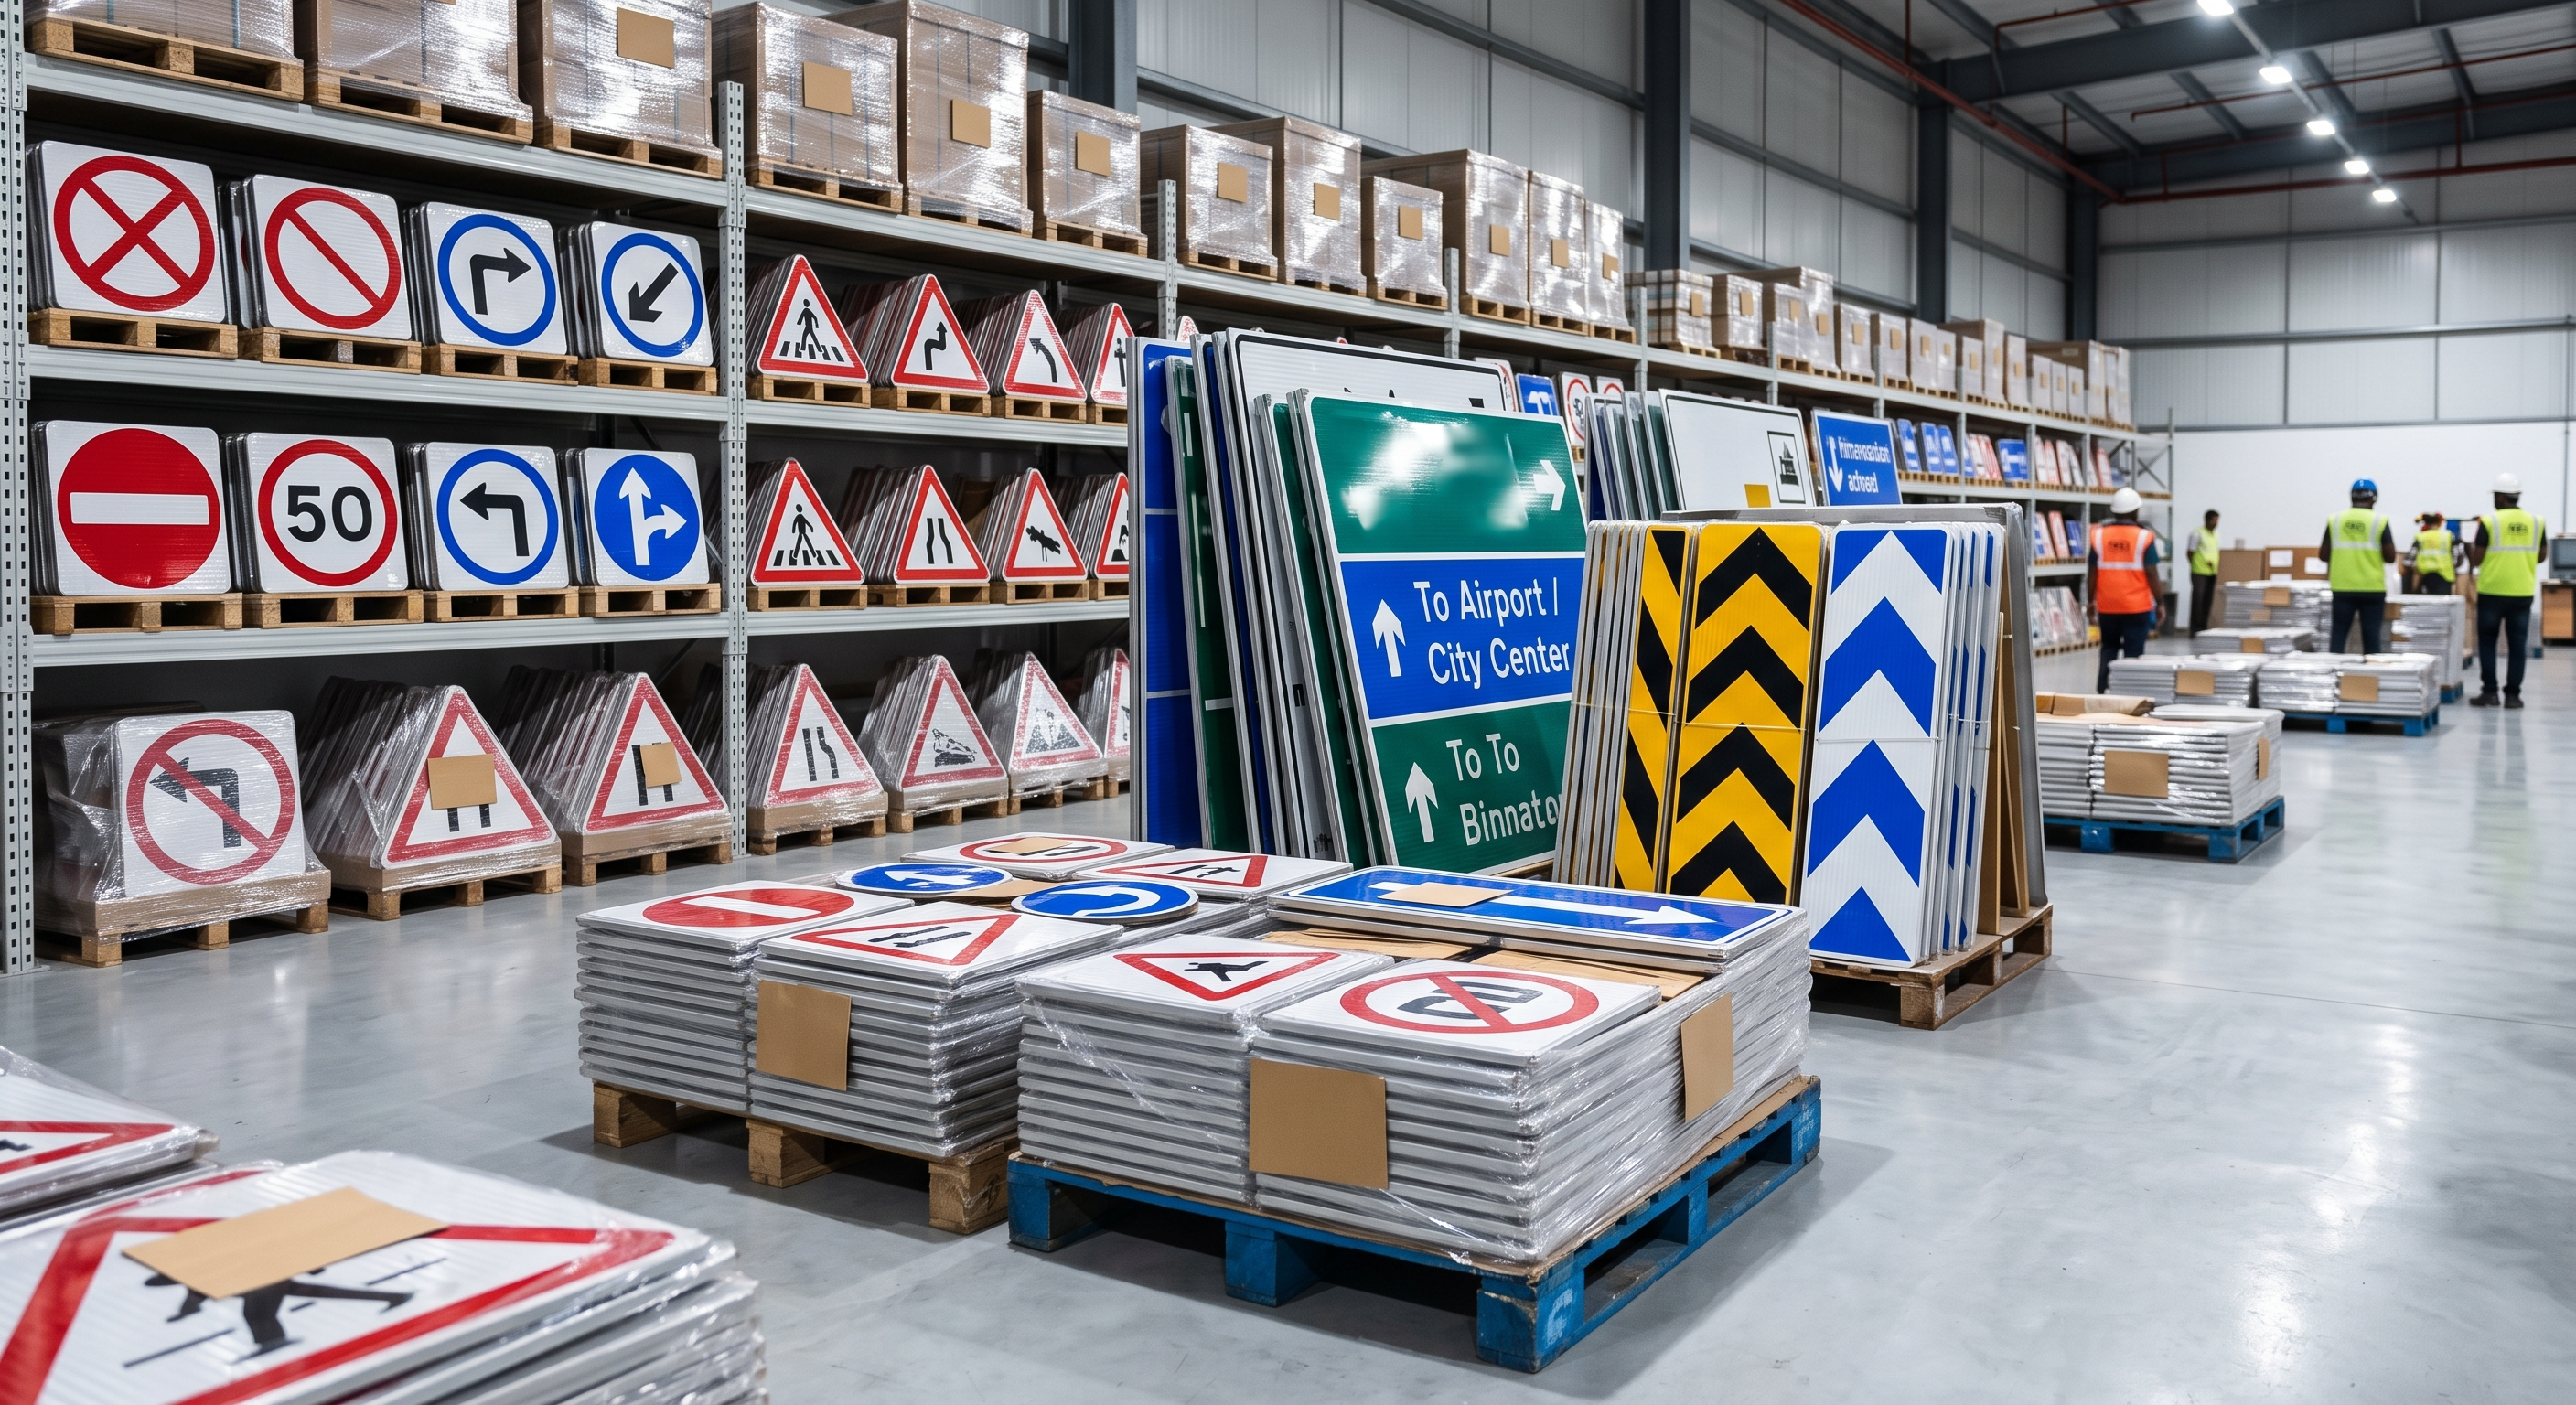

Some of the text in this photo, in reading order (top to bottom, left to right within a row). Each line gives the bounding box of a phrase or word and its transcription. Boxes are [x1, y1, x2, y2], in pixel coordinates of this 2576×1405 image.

[287, 485, 372, 542] 50
[1412, 581, 1450, 622] To
[1460, 579, 1547, 627] Airport
[1428, 636, 1570, 690] City Center
[1446, 733, 1519, 780] To To
[1459, 789, 1562, 846] Binnato
